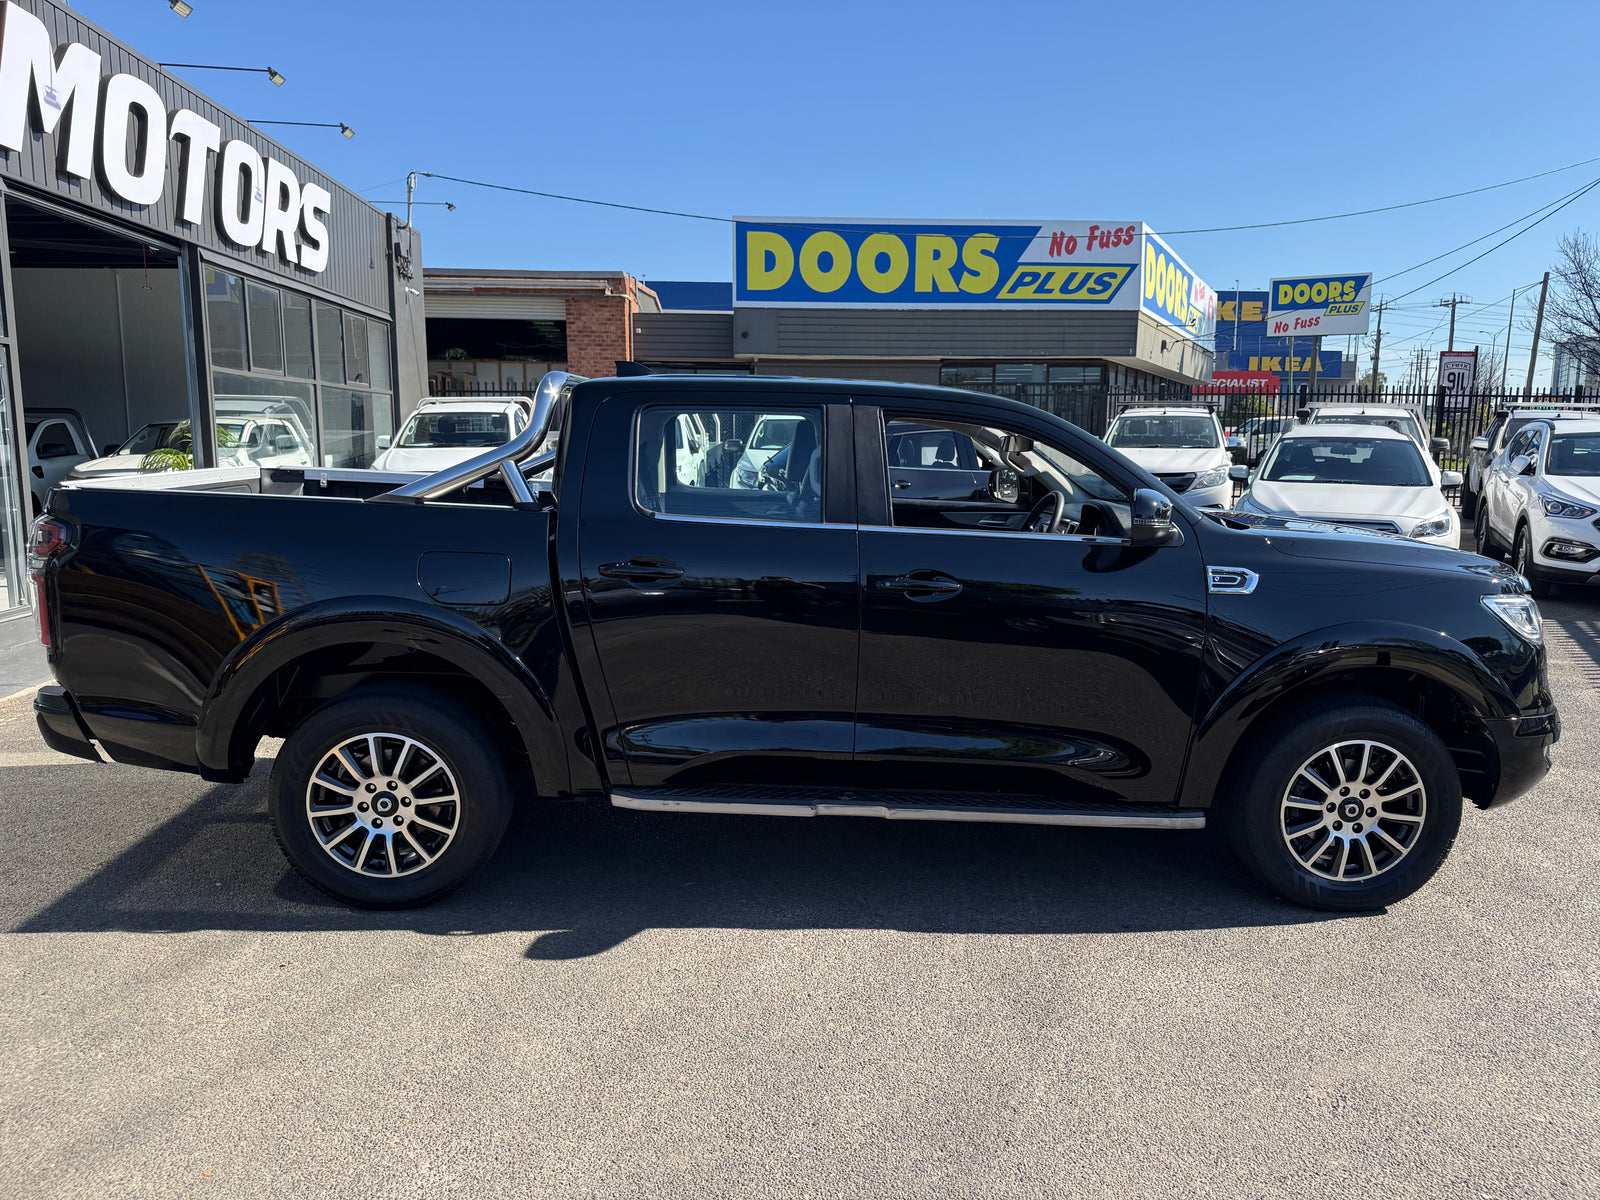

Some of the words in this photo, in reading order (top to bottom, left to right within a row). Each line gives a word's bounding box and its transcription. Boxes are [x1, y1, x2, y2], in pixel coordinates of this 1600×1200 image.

[0, 1, 331, 273] MOTORS
[1049, 231, 1078, 258] No
[1086, 224, 1136, 252] Fuss
[746, 230, 1000, 294] DOORS
[1006, 270, 1119, 296] PLUS
[1145, 242, 1189, 324] DOORS
[1278, 280, 1356, 305] DOORS
[1216, 301, 1269, 322] KE
[1328, 304, 1360, 315] PLUS
[1273, 320, 1290, 334] No
[1293, 316, 1321, 331] Fuss
[1248, 356, 1323, 372] IKEA
